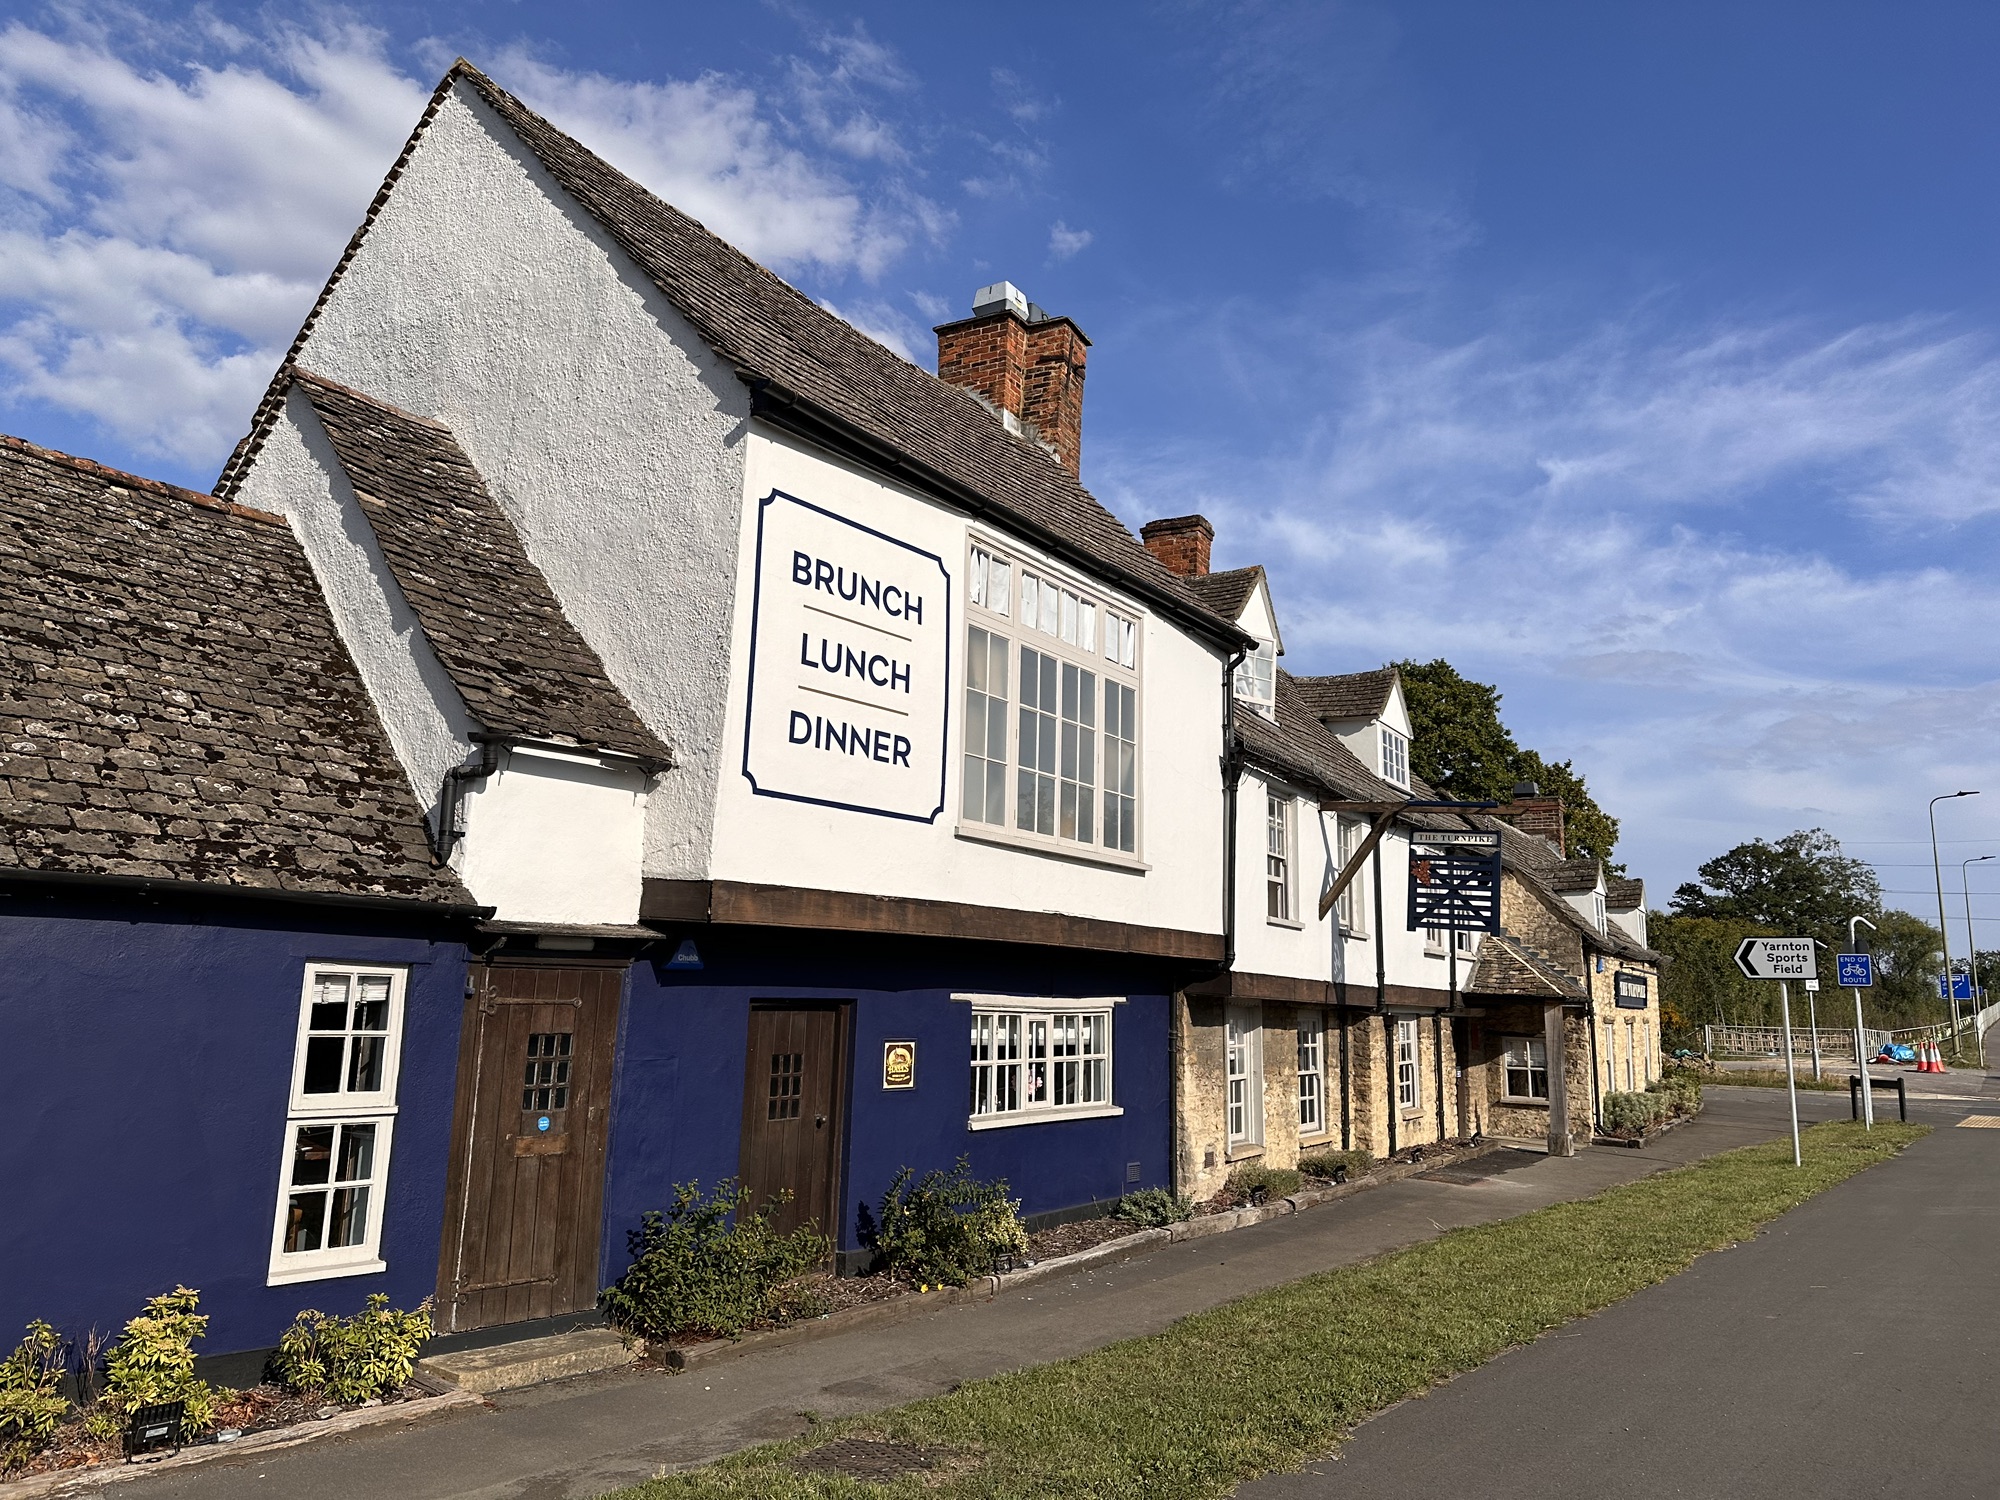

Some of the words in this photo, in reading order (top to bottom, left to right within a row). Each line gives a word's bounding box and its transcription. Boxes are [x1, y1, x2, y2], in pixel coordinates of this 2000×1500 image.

[792, 550, 923, 625] BRUNCH
[801, 633, 910, 694] LUNCH
[789, 710, 912, 768] DINNER
[1440, 834, 1493, 842] TURNPIKE
[1761, 942, 1810, 951] Yarnton
[1766, 953, 1808, 964] Sports
[1773, 965, 1803, 974] Field
